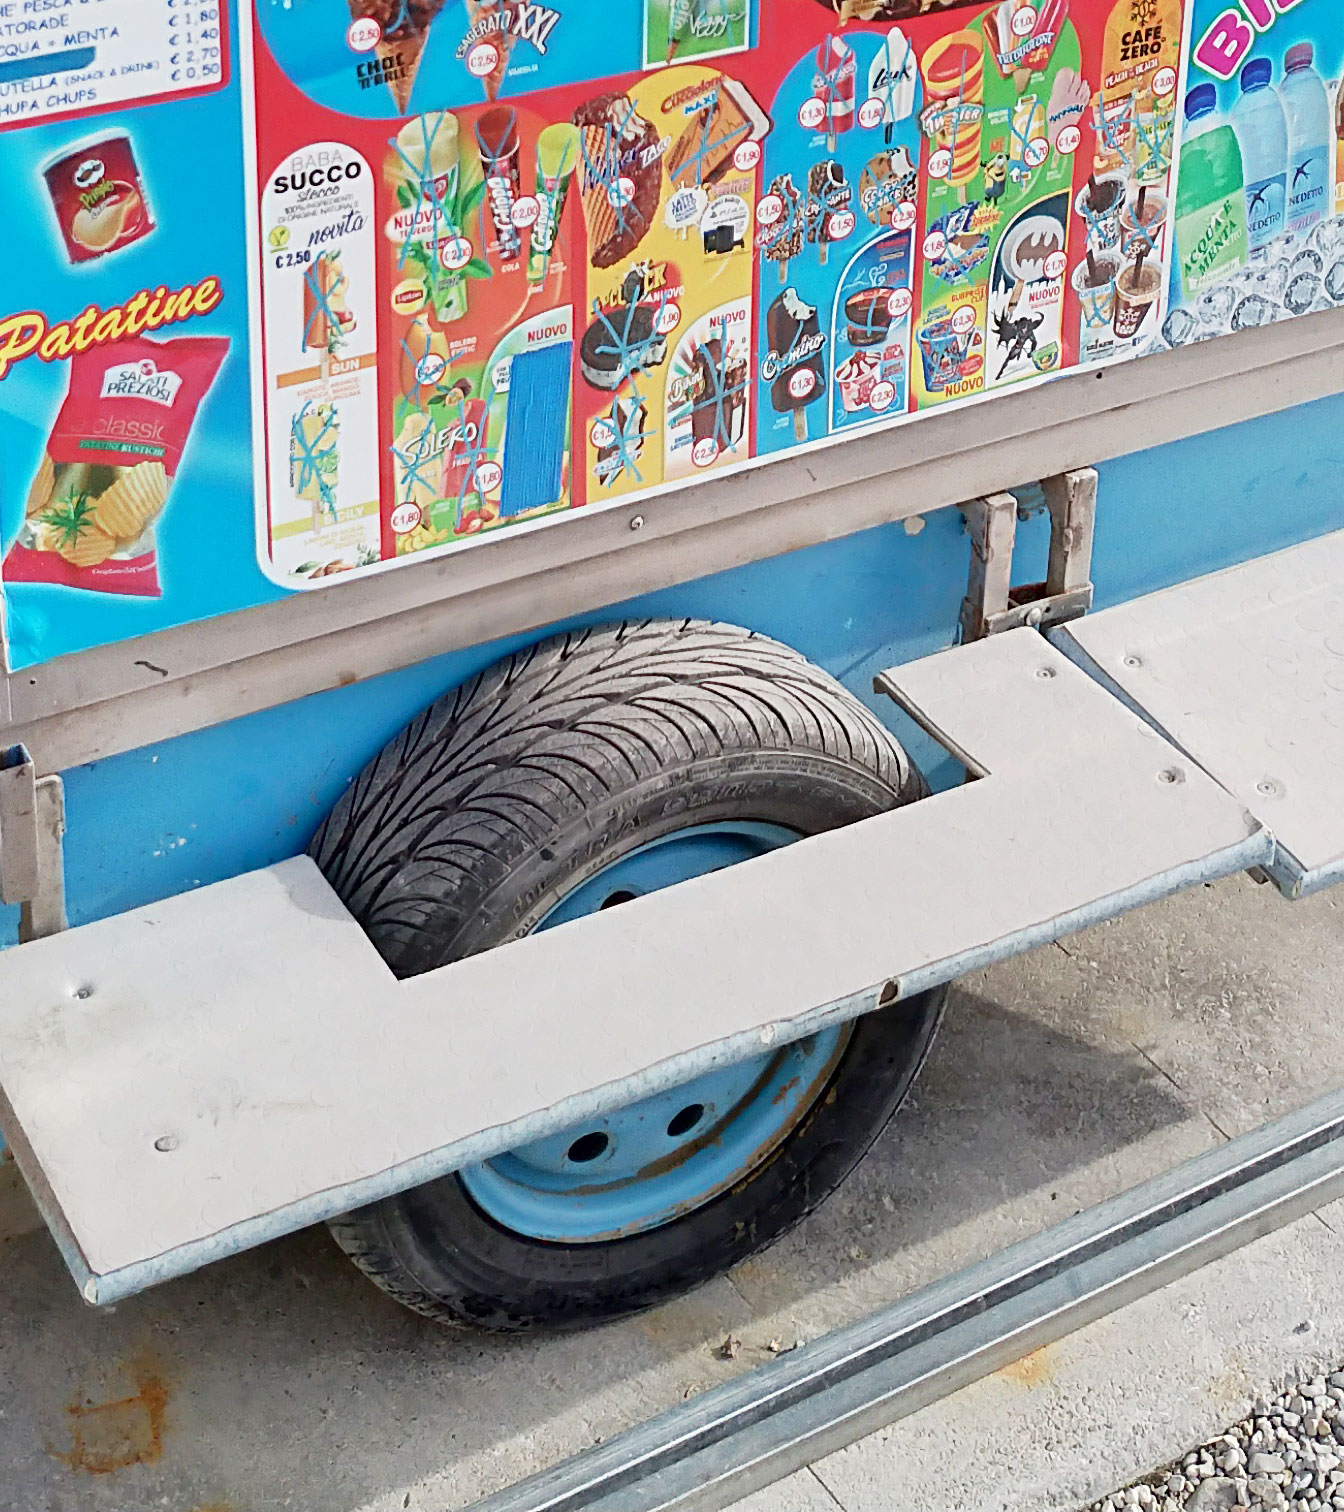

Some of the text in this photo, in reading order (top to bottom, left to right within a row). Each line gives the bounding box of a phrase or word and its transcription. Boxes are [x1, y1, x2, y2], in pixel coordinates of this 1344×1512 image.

[64, 26, 119, 46] MENTA
[513, 4, 561, 56] XXL
[1120, 42, 1161, 62] ZERO
[46, 88, 97, 107] CHUPS
[291, 149, 343, 172] BABA
[274, 161, 361, 194] SUCCO
[394, 208, 443, 230] NUOVO
[1199, 220, 1237, 276] MENTA
[1028, 286, 1060, 303] NUOVO
[709, 310, 746, 328] NUOVO
[527, 324, 567, 343] NUOVO
[331, 359, 360, 374] SUN
[107, 382, 170, 401] PREZIOSI
[945, 375, 984, 397] NUOVO
[400, 422, 479, 468] SOLERO
